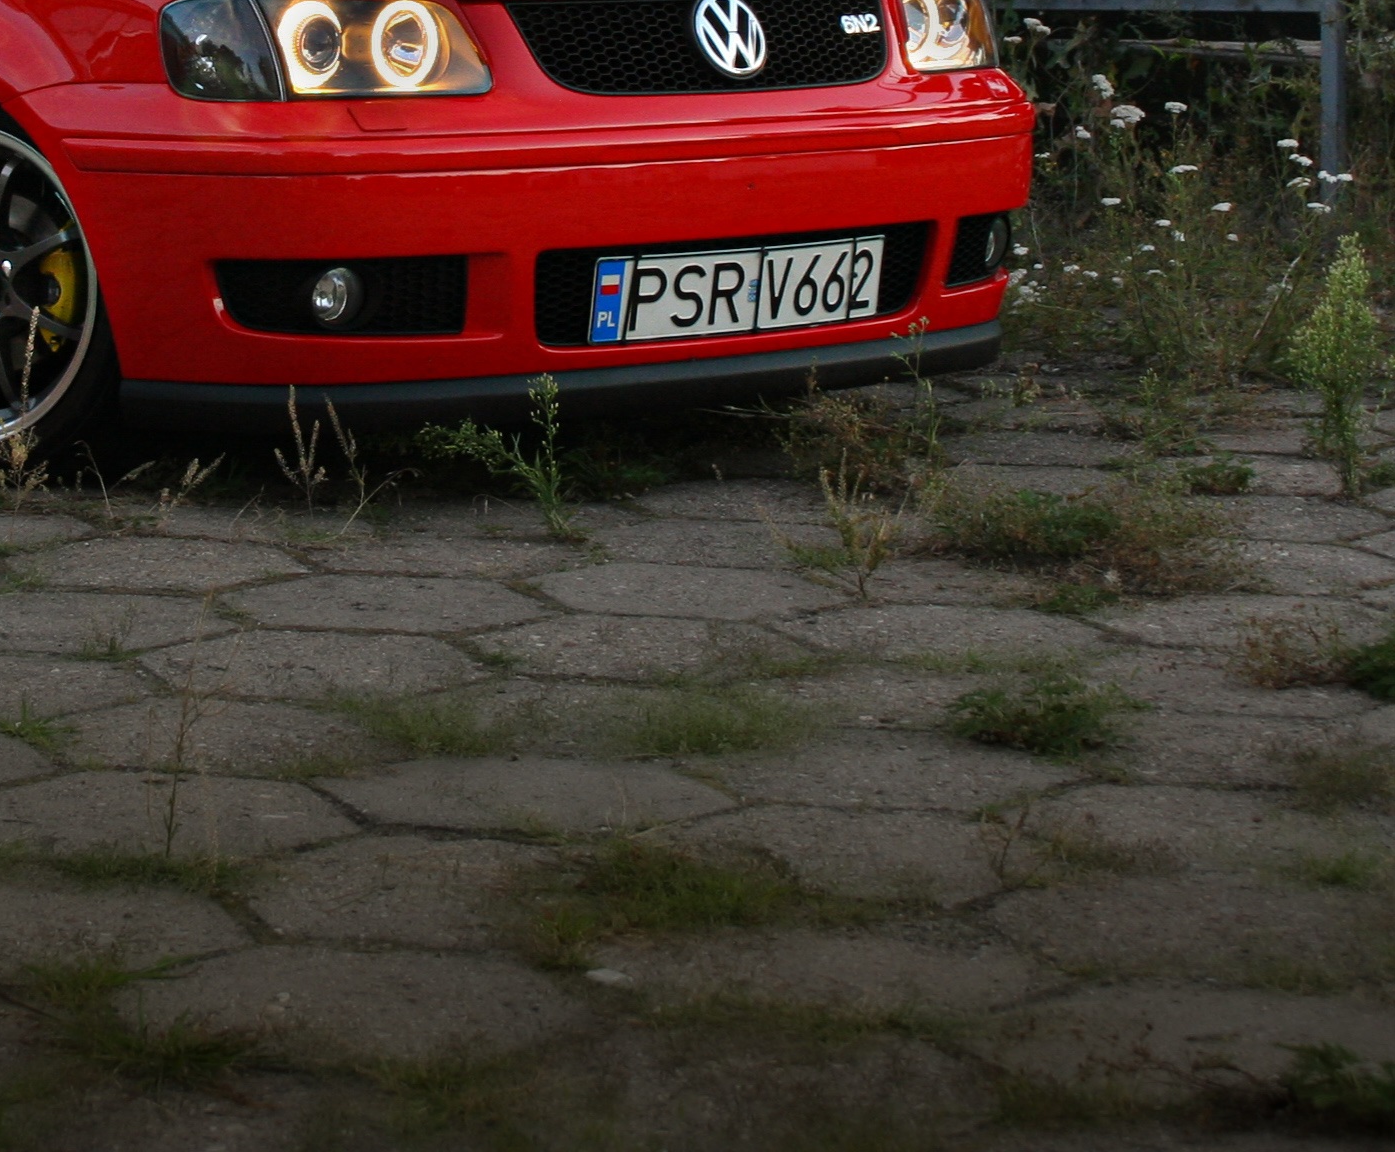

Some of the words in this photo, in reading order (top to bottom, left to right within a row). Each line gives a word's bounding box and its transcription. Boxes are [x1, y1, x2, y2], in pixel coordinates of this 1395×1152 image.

[840, 13, 881, 34] 6N2
[628, 262, 745, 332] PSR
[767, 248, 874, 320] V662
[596, 311, 616, 328] PL
